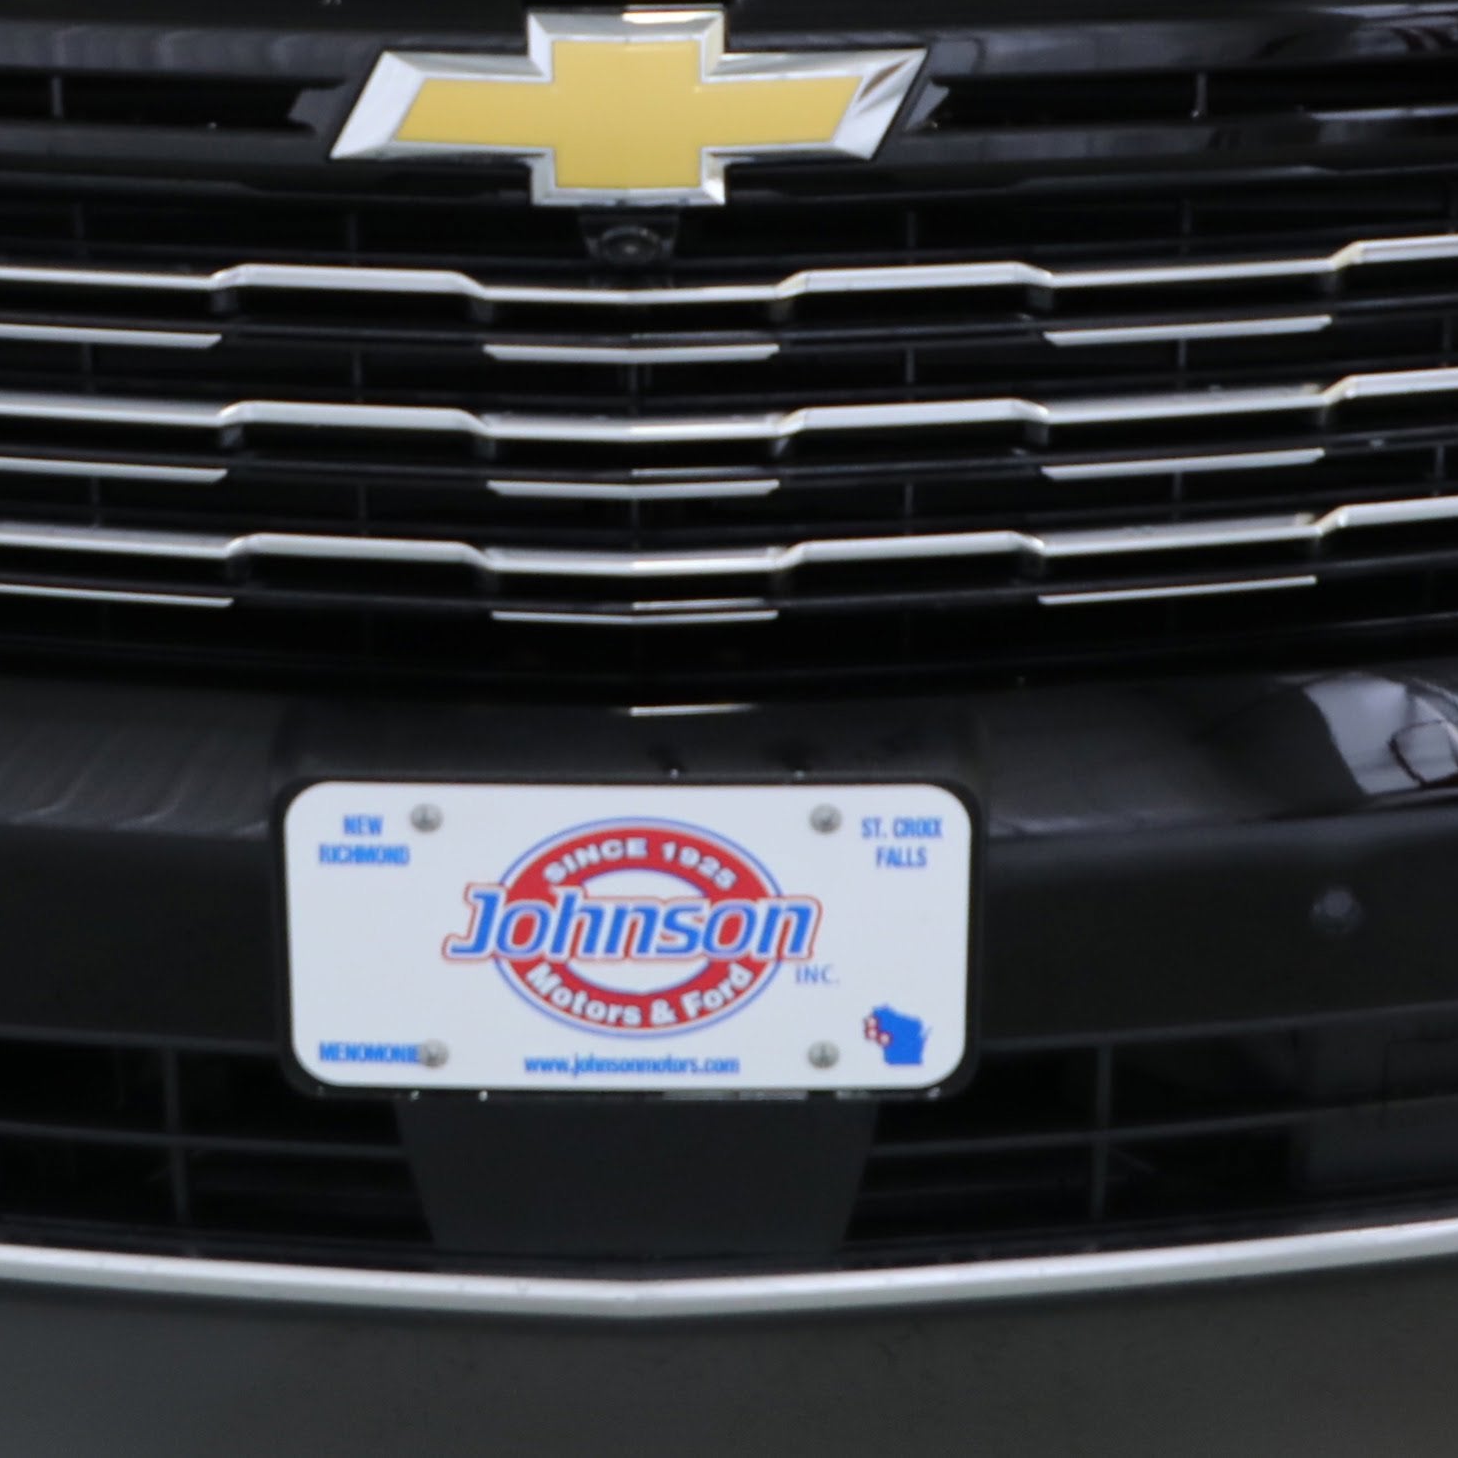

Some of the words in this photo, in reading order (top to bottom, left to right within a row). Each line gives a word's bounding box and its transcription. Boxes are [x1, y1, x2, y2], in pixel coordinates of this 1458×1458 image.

[343, 814, 383, 836] NEW
[862, 817, 888, 839] ST.
[319, 844, 410, 865] RICHMOND
[544, 837, 648, 884] SINCE
[662, 840, 739, 890] 1925
[876, 846, 927, 868] FALLS
[446, 886, 818, 958] Johnson
[795, 966, 840, 986] INC.
[525, 961, 642, 1027] Motors
[649, 998, 678, 1027] &
[680, 962, 754, 1020] Ford
[524, 1053, 740, 1076] www.johnsonmotors.com
